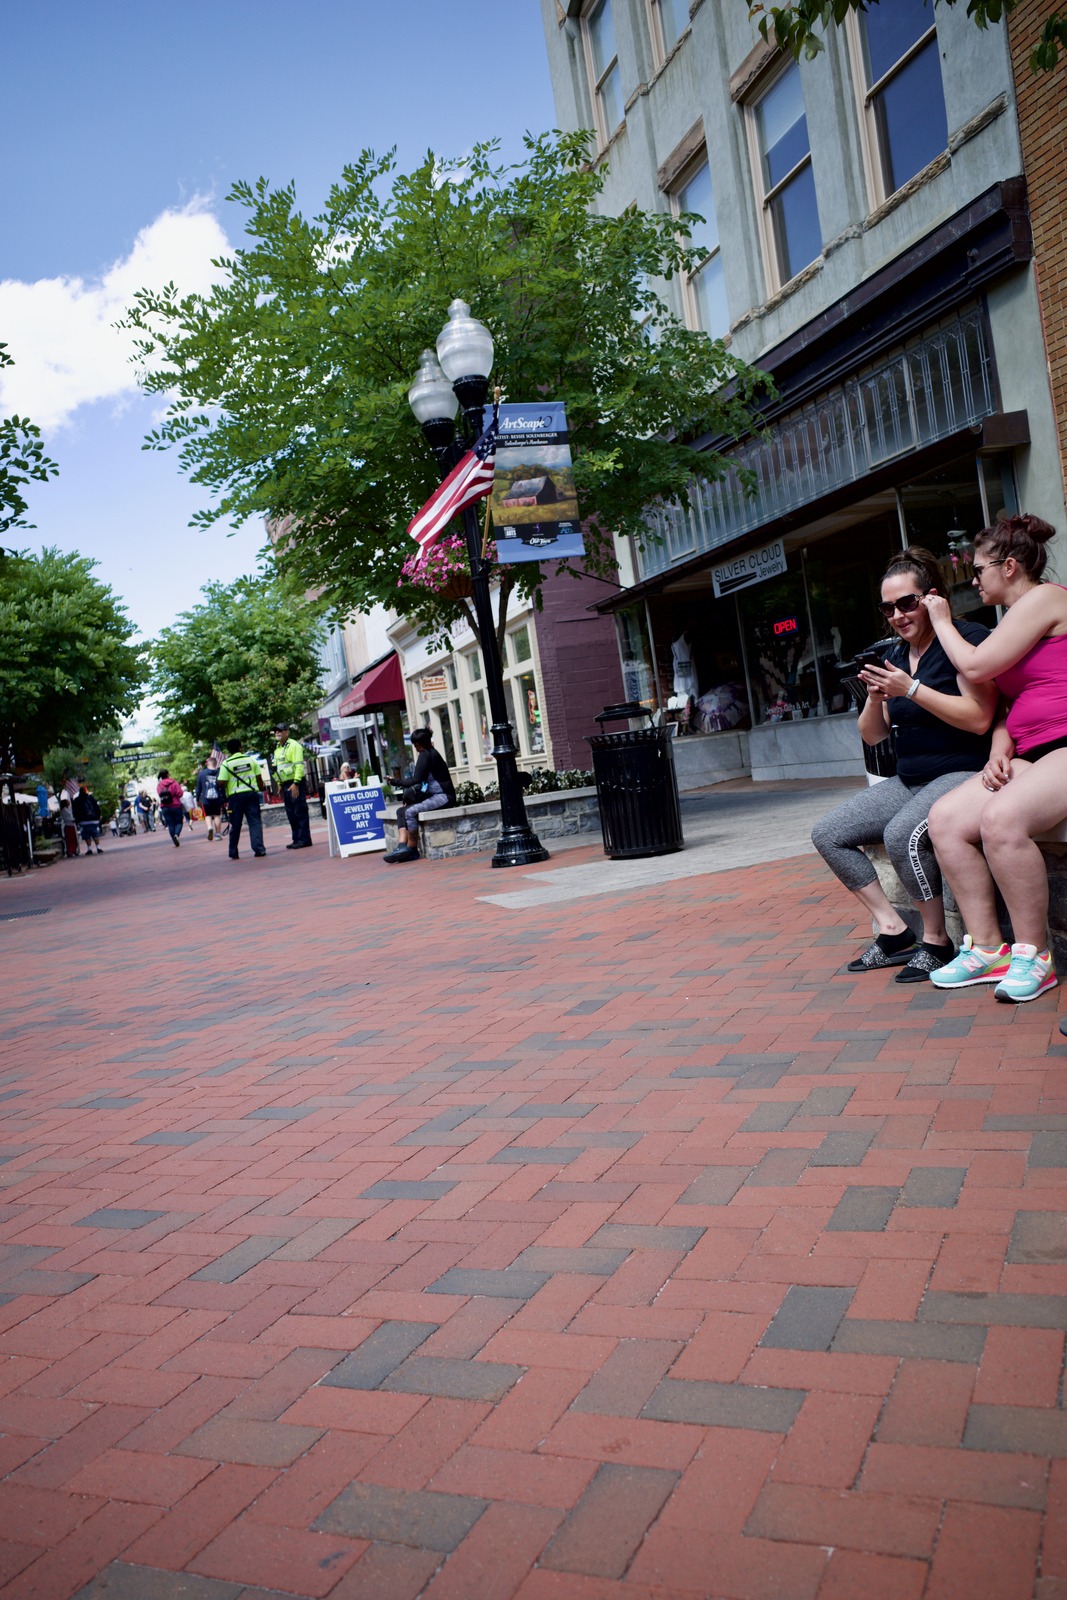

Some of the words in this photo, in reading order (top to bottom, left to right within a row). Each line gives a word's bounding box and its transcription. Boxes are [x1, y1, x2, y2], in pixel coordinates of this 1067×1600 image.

[499, 416, 545, 431] ArtScape
[714, 559, 747, 583] SILVER
[748, 543, 782, 569] CLOUD
[758, 560, 784, 578] Jewelry
[773, 617, 797, 635] OPEN
[333, 794, 356, 804] SILVER
[356, 790, 379, 800] CLOUD
[344, 803, 374, 815] JEWELRY
[351, 812, 371, 822] GIFTS
[356, 820, 369, 829] ART
[916, 821, 929, 835] LOVE
[909, 835, 919, 853] LOVE
